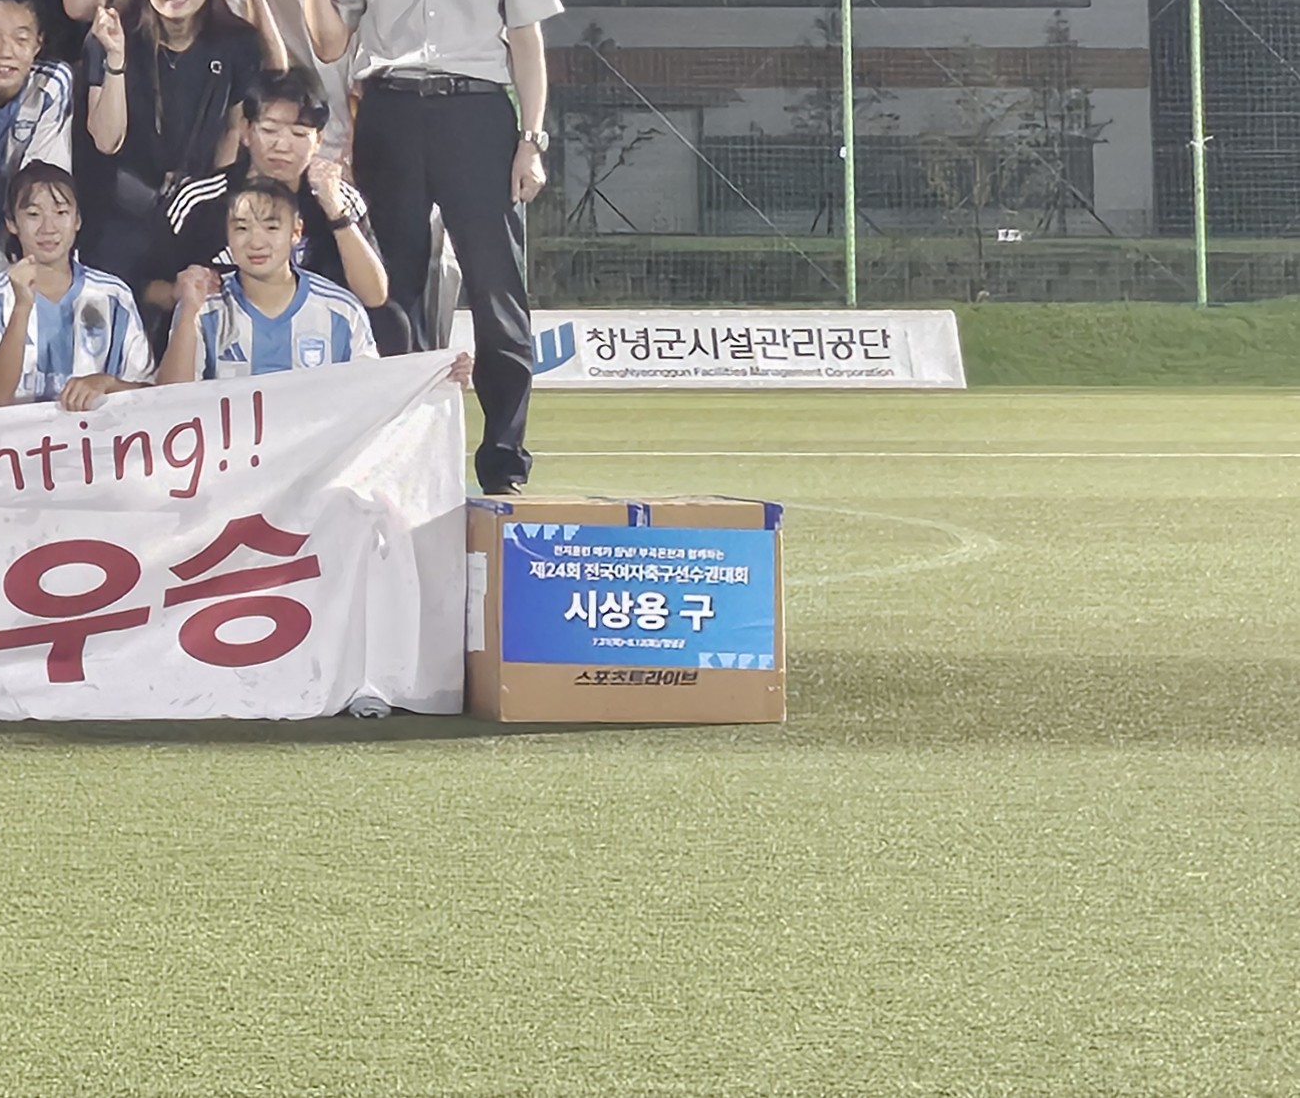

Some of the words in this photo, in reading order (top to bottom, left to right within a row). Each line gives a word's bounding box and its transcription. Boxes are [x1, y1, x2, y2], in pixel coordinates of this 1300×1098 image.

[586, 327, 892, 361] 창녕군시설관리공단
[825, 366, 895, 378] Corporation
[529, 560, 580, 582] 제24회
[584, 561, 749, 584] 전국여자축구선수권대회
[563, 591, 669, 630] 시상용
[679, 594, 715, 631] 구
